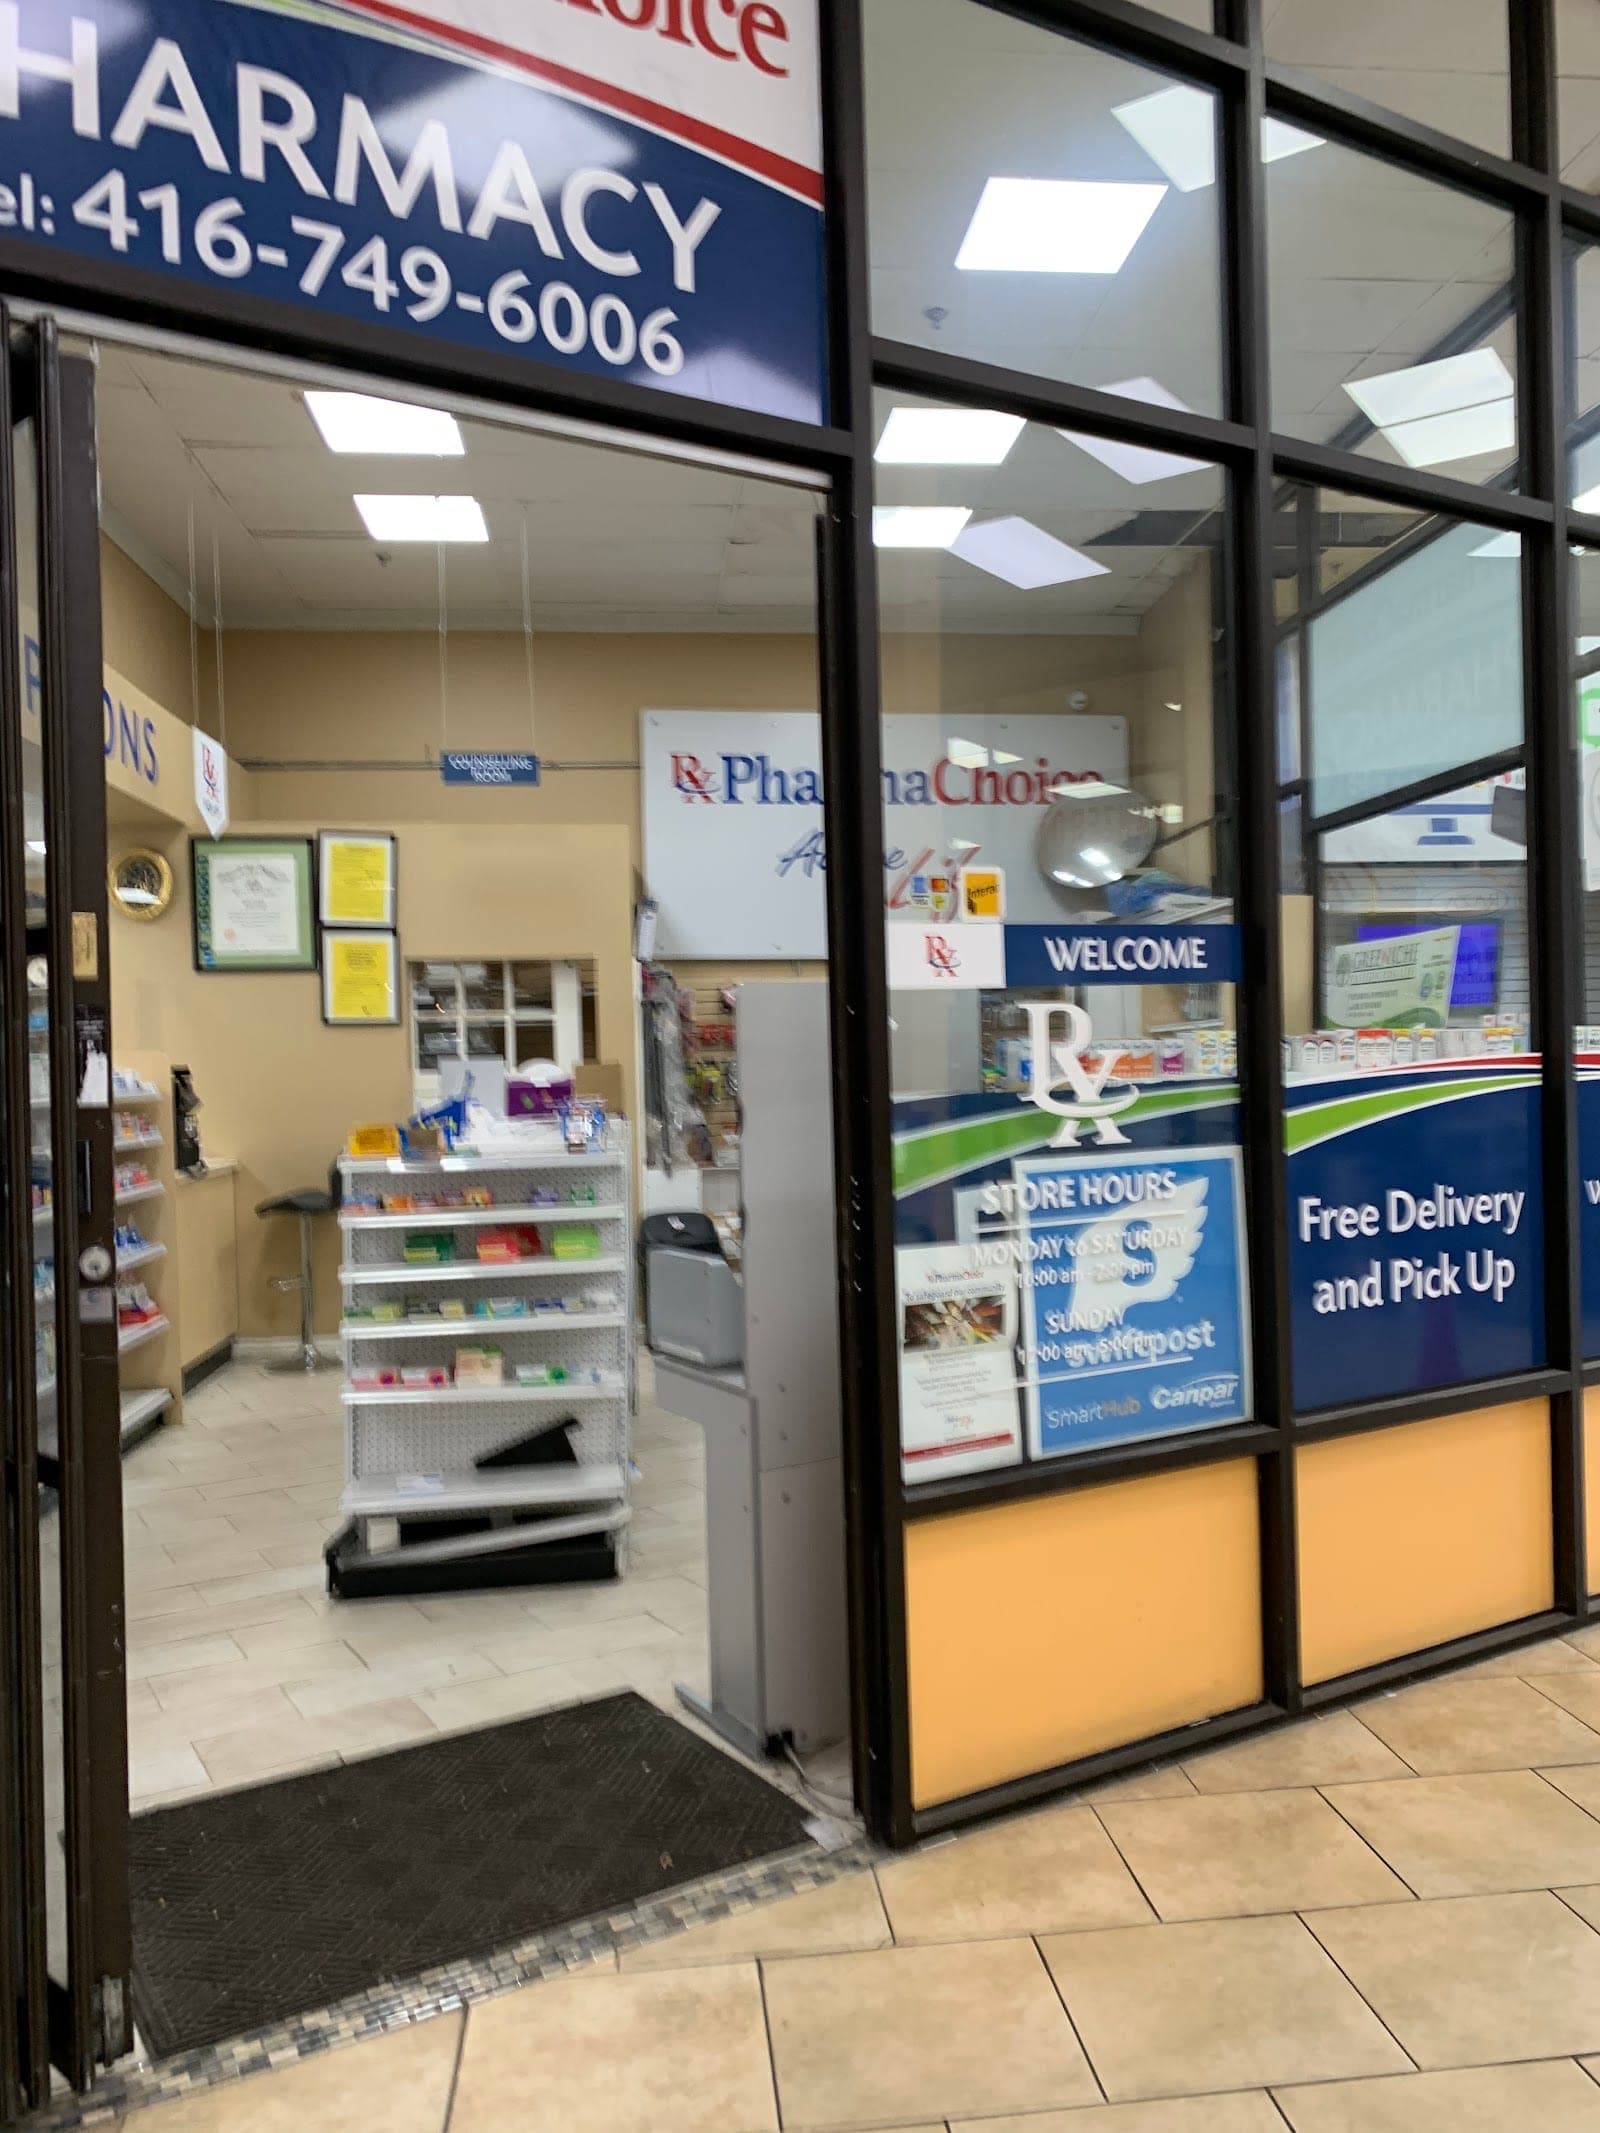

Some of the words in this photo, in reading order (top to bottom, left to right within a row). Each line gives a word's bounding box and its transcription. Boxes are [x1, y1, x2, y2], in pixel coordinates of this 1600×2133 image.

[72, 168, 685, 377] 416-749-6006
[1043, 936, 1209, 972] WELCOME
[980, 1178, 1076, 1215] STORE
[1079, 1169, 1178, 1206] HOURS
[1299, 1196, 1380, 1242] Free
[1385, 1183, 1525, 1236] Delivery
[973, 1236, 1064, 1266] MONDAY
[1065, 1235, 1088, 1257] to
[1088, 1224, 1188, 1256] SATURDAY
[1313, 1260, 1384, 1313] and
[1389, 1250, 1462, 1303] Pick
[1465, 1247, 1517, 1303] Up
[1045, 1306, 1124, 1336] SUNDAY
